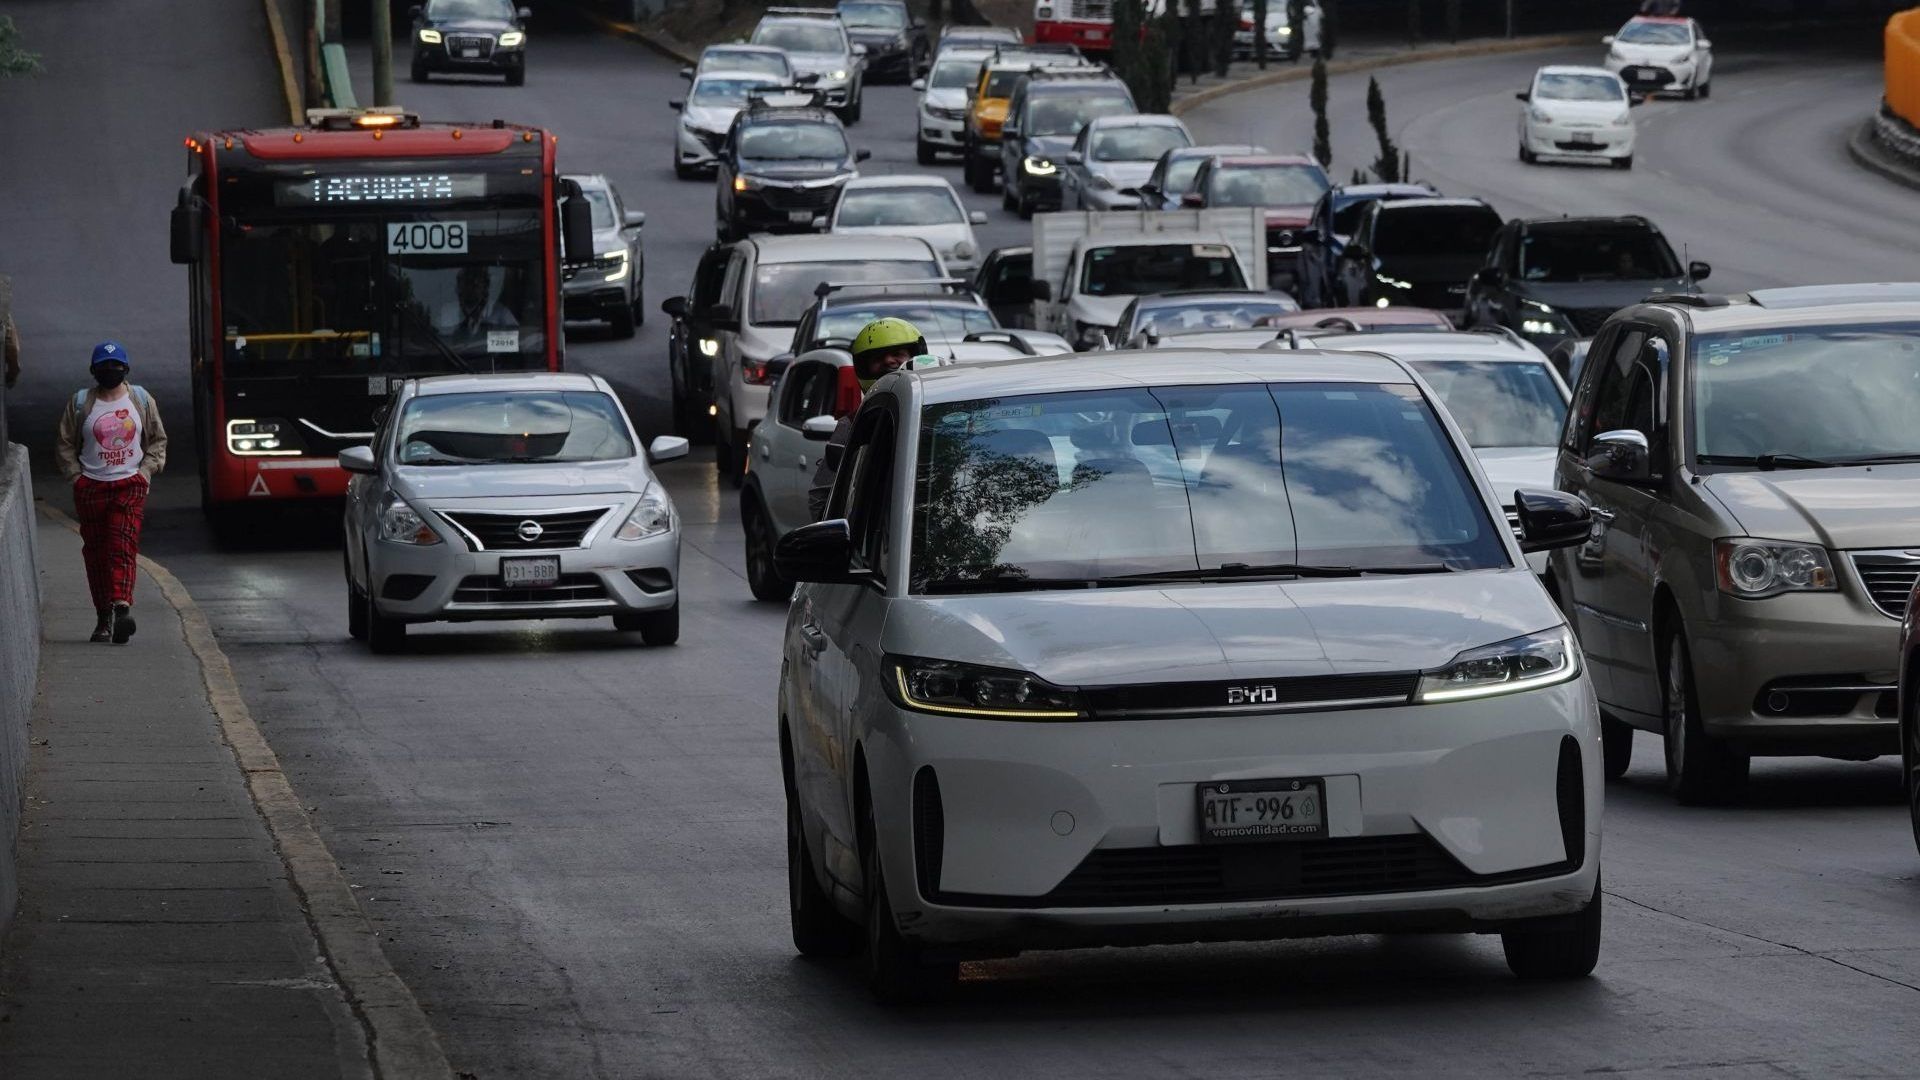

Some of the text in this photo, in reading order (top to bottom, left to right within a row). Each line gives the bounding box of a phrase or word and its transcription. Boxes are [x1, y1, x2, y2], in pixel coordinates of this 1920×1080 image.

[393, 224, 464, 249] 4008
[98, 449, 134, 460] TODAY'S
[1228, 685, 1277, 704] BYD
[1213, 824, 1317, 837] vemovilidad.com
